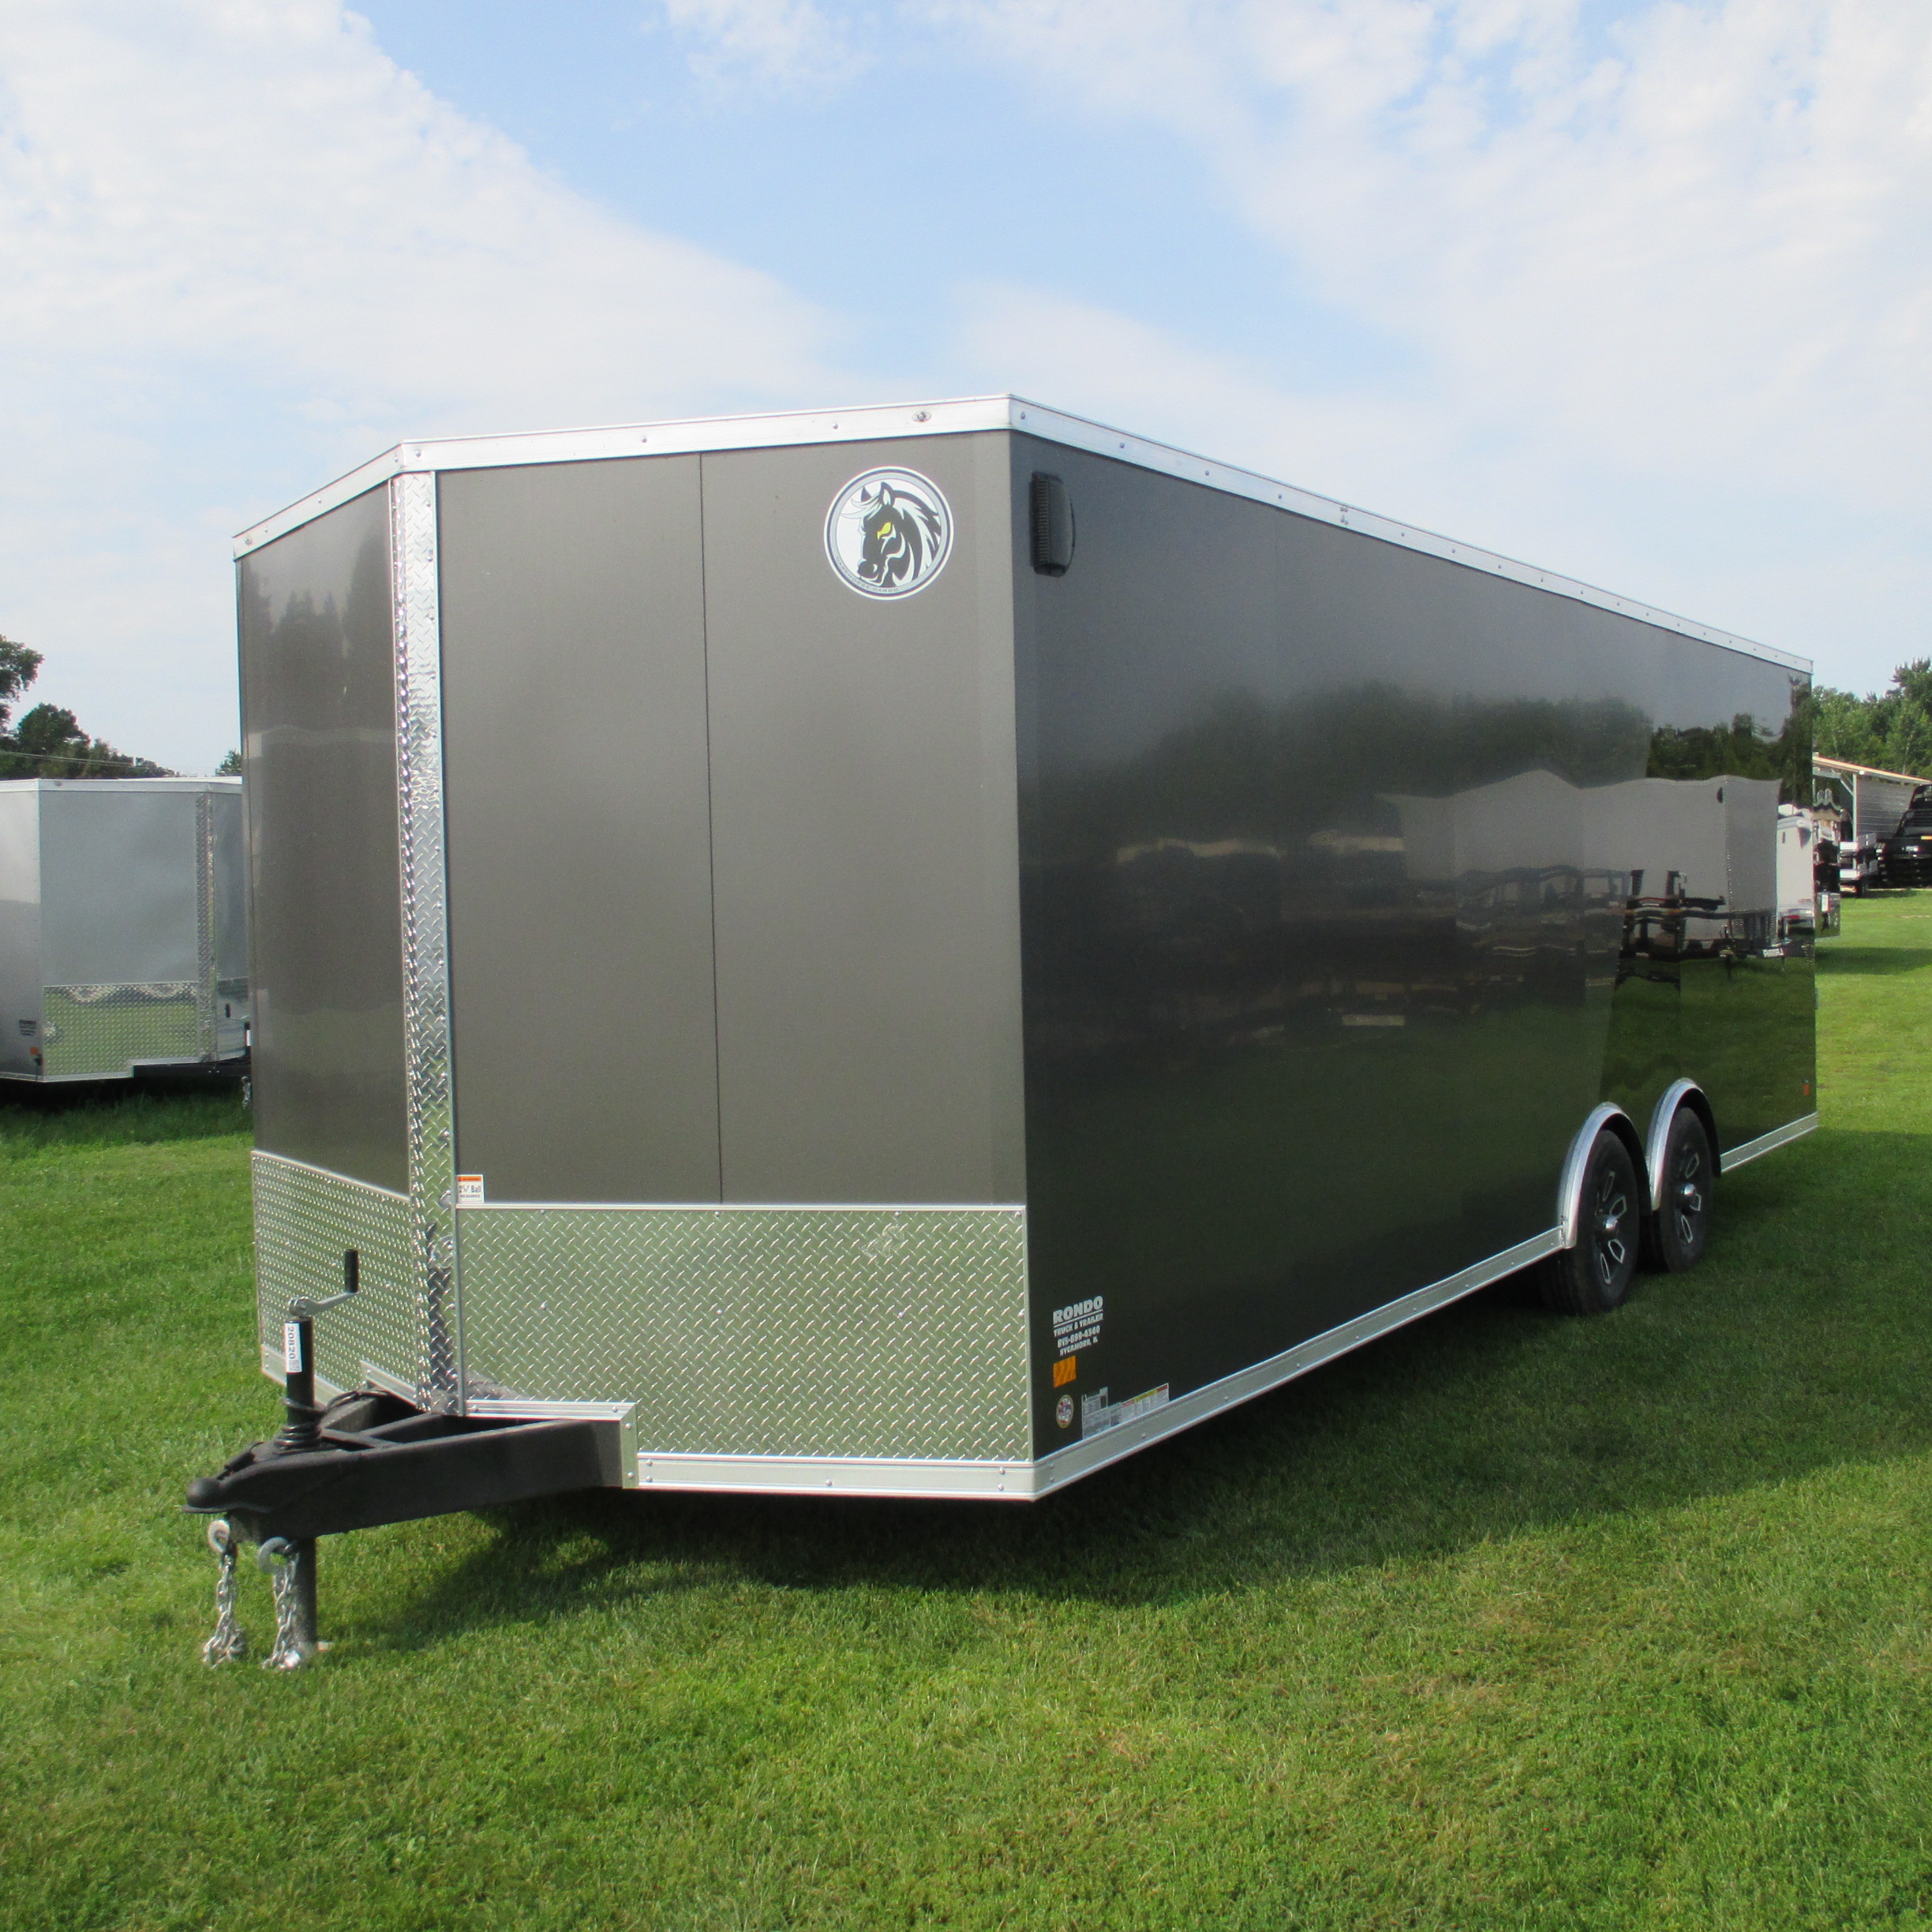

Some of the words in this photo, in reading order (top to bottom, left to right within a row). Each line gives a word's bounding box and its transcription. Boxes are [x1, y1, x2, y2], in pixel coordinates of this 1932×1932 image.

[1053, 1295, 1103, 1324] RONDO
[1054, 1324, 1073, 1337] TRUCK
[1074, 1321, 1078, 1330] &
[1080, 1312, 1103, 1327] TRAILER
[287, 1326, 296, 1359] 20820
